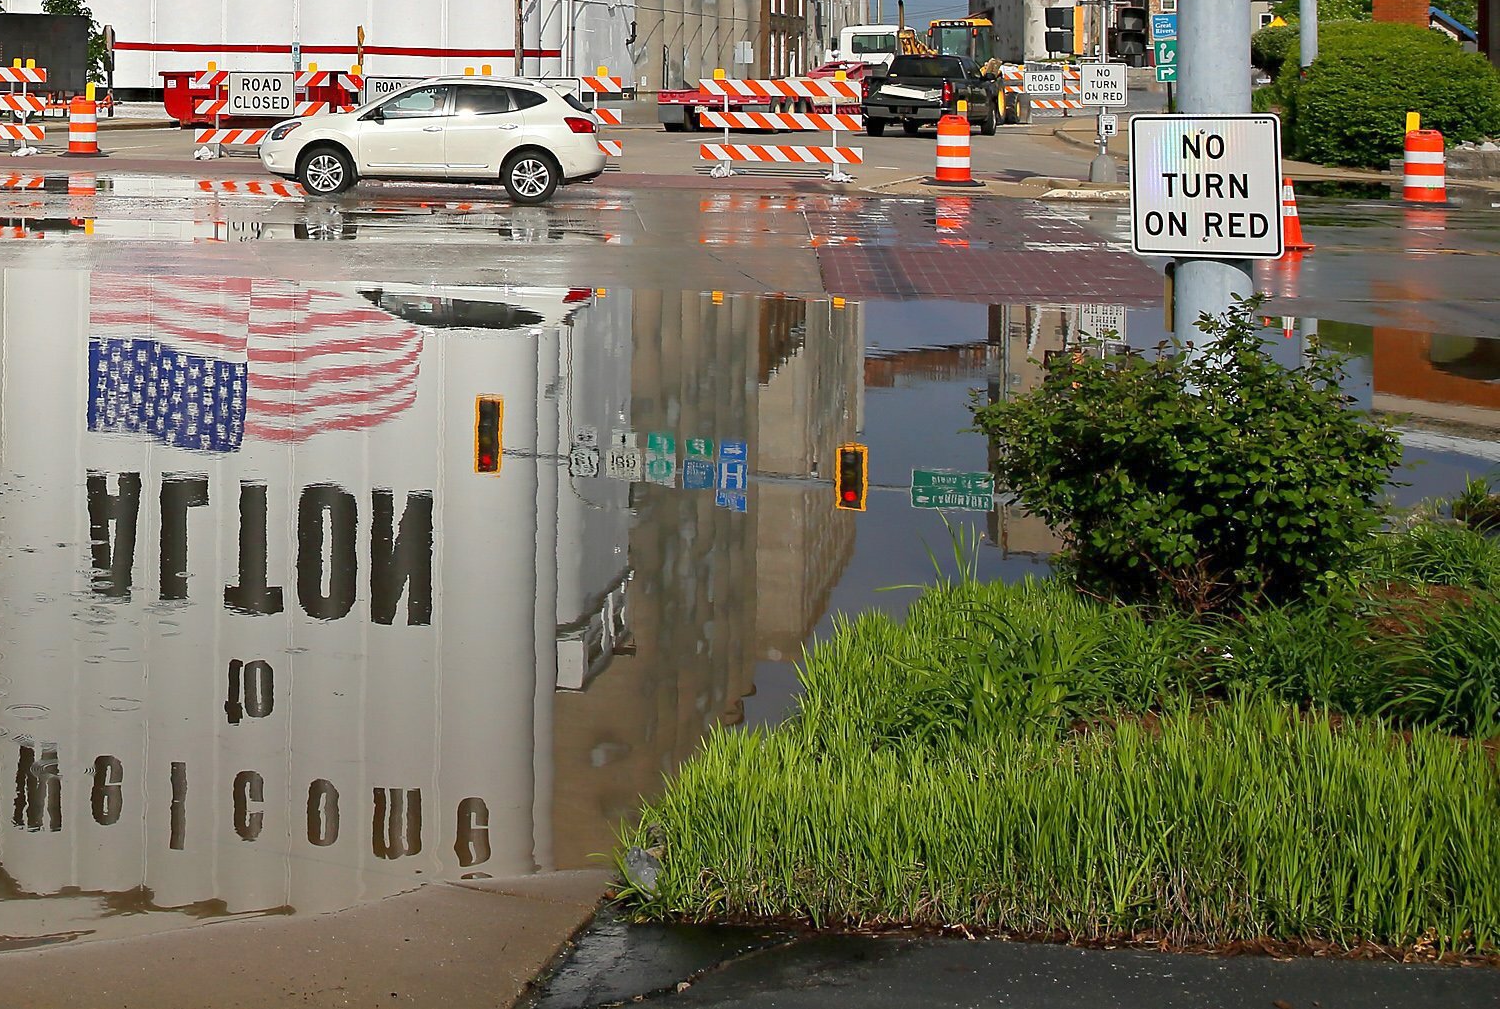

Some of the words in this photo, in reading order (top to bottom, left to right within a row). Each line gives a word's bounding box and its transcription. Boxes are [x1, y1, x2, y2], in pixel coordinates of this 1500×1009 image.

[1031, 74, 1056, 82] ROAD
[1096, 69, 1111, 77] NO
[241, 78, 282, 92] ROAD
[1027, 83, 1061, 92] CLOSED
[1090, 80, 1118, 89] TURN
[1084, 92, 1098, 101] ON
[1103, 93, 1123, 101] RED
[233, 95, 290, 110] CLOSED
[1182, 134, 1225, 160] NO
[1161, 173, 1249, 199] TURN
[1145, 210, 1187, 237] ON
[1204, 212, 1269, 239] RED
